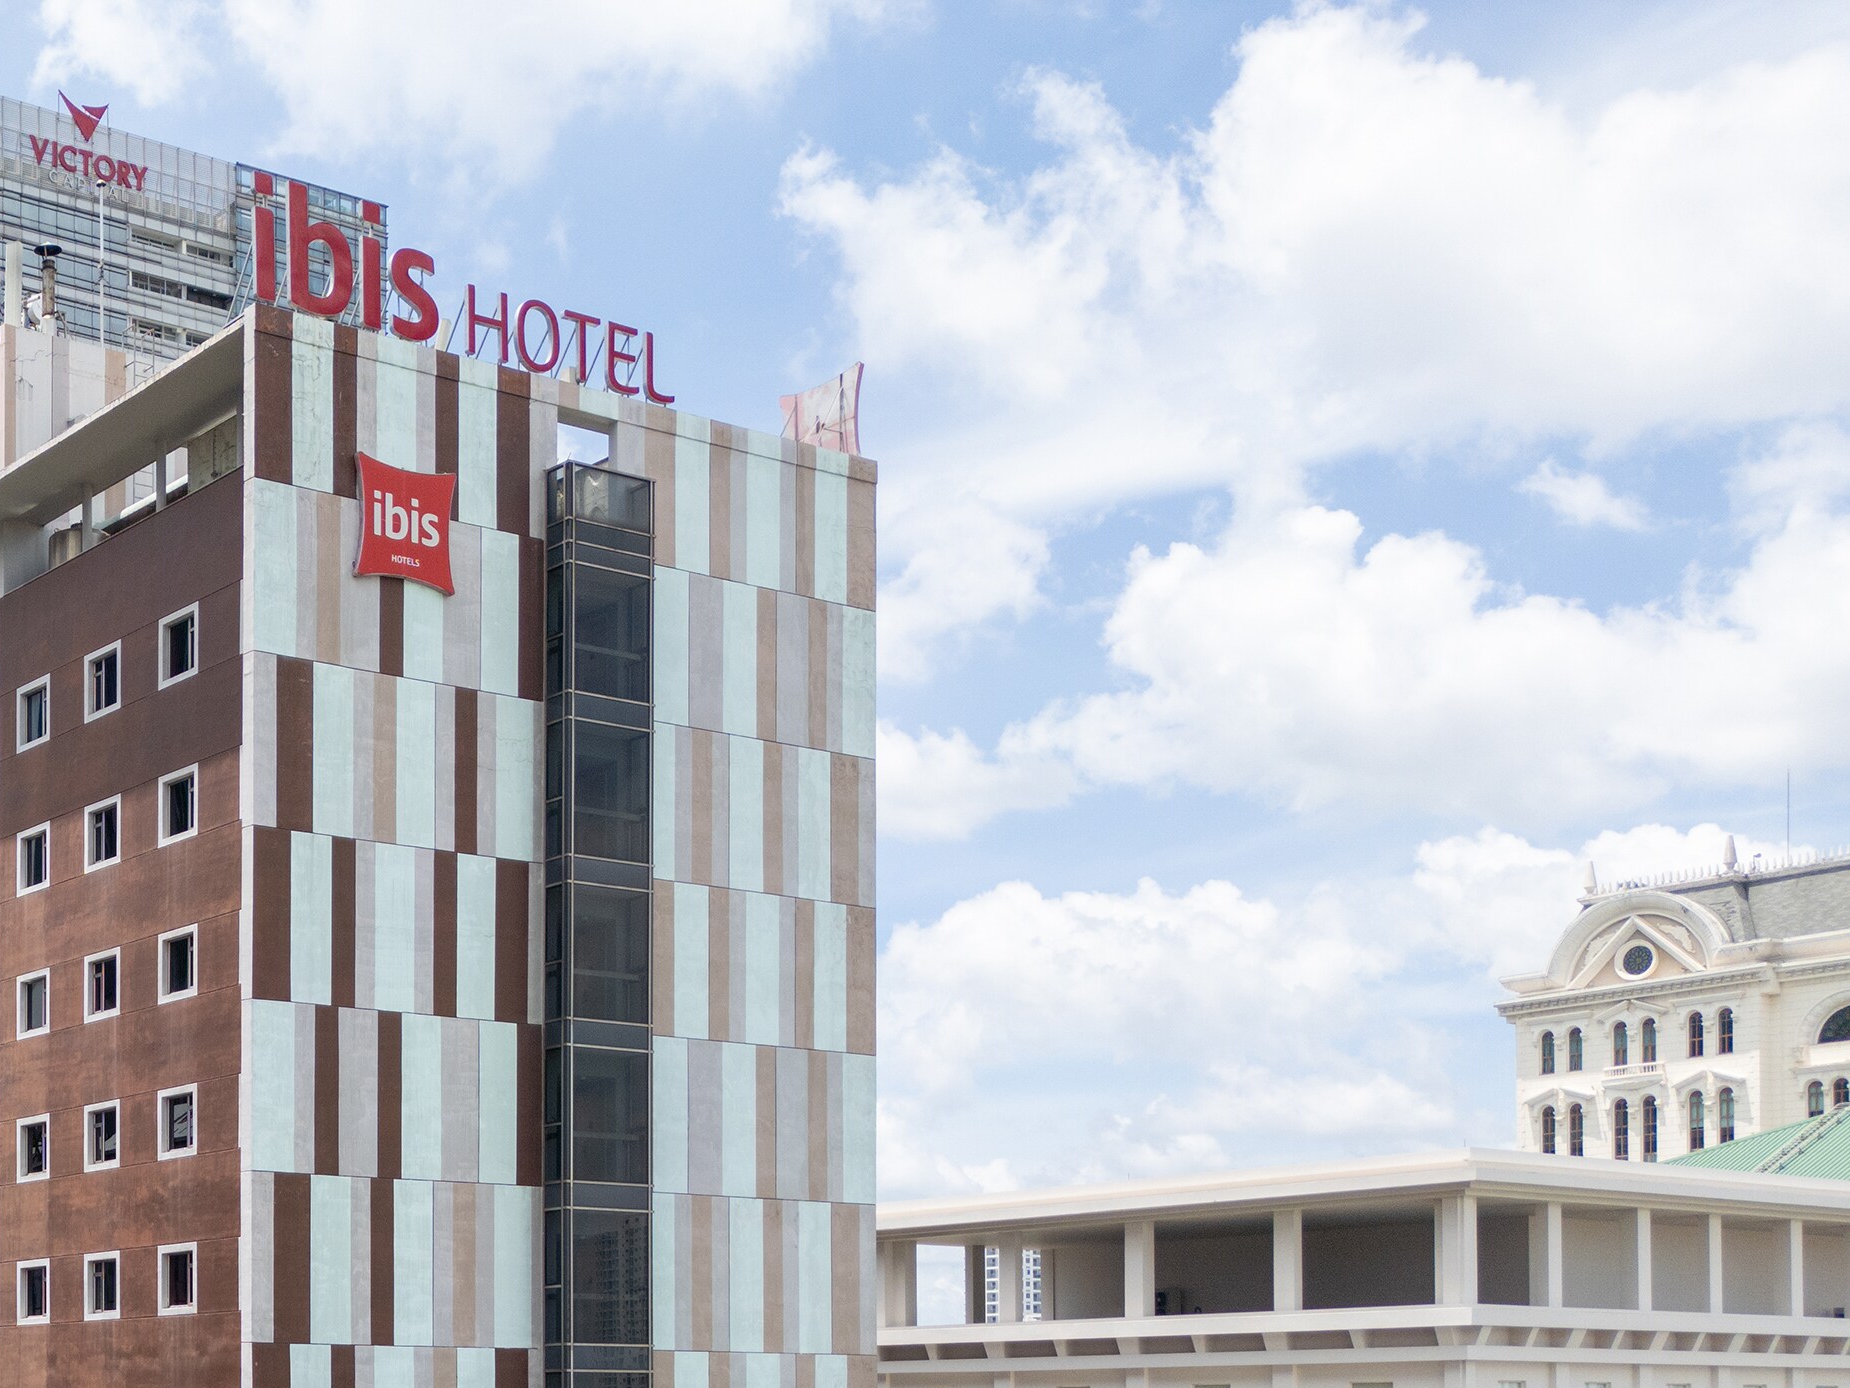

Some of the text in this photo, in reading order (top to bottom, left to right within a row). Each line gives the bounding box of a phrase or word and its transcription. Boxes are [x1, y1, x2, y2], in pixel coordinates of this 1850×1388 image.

[29, 134, 148, 191] VICTORY
[252, 170, 675, 405] ibis HOTEL
[373, 490, 440, 548] ibis
[391, 554, 420, 567] HOTELS
